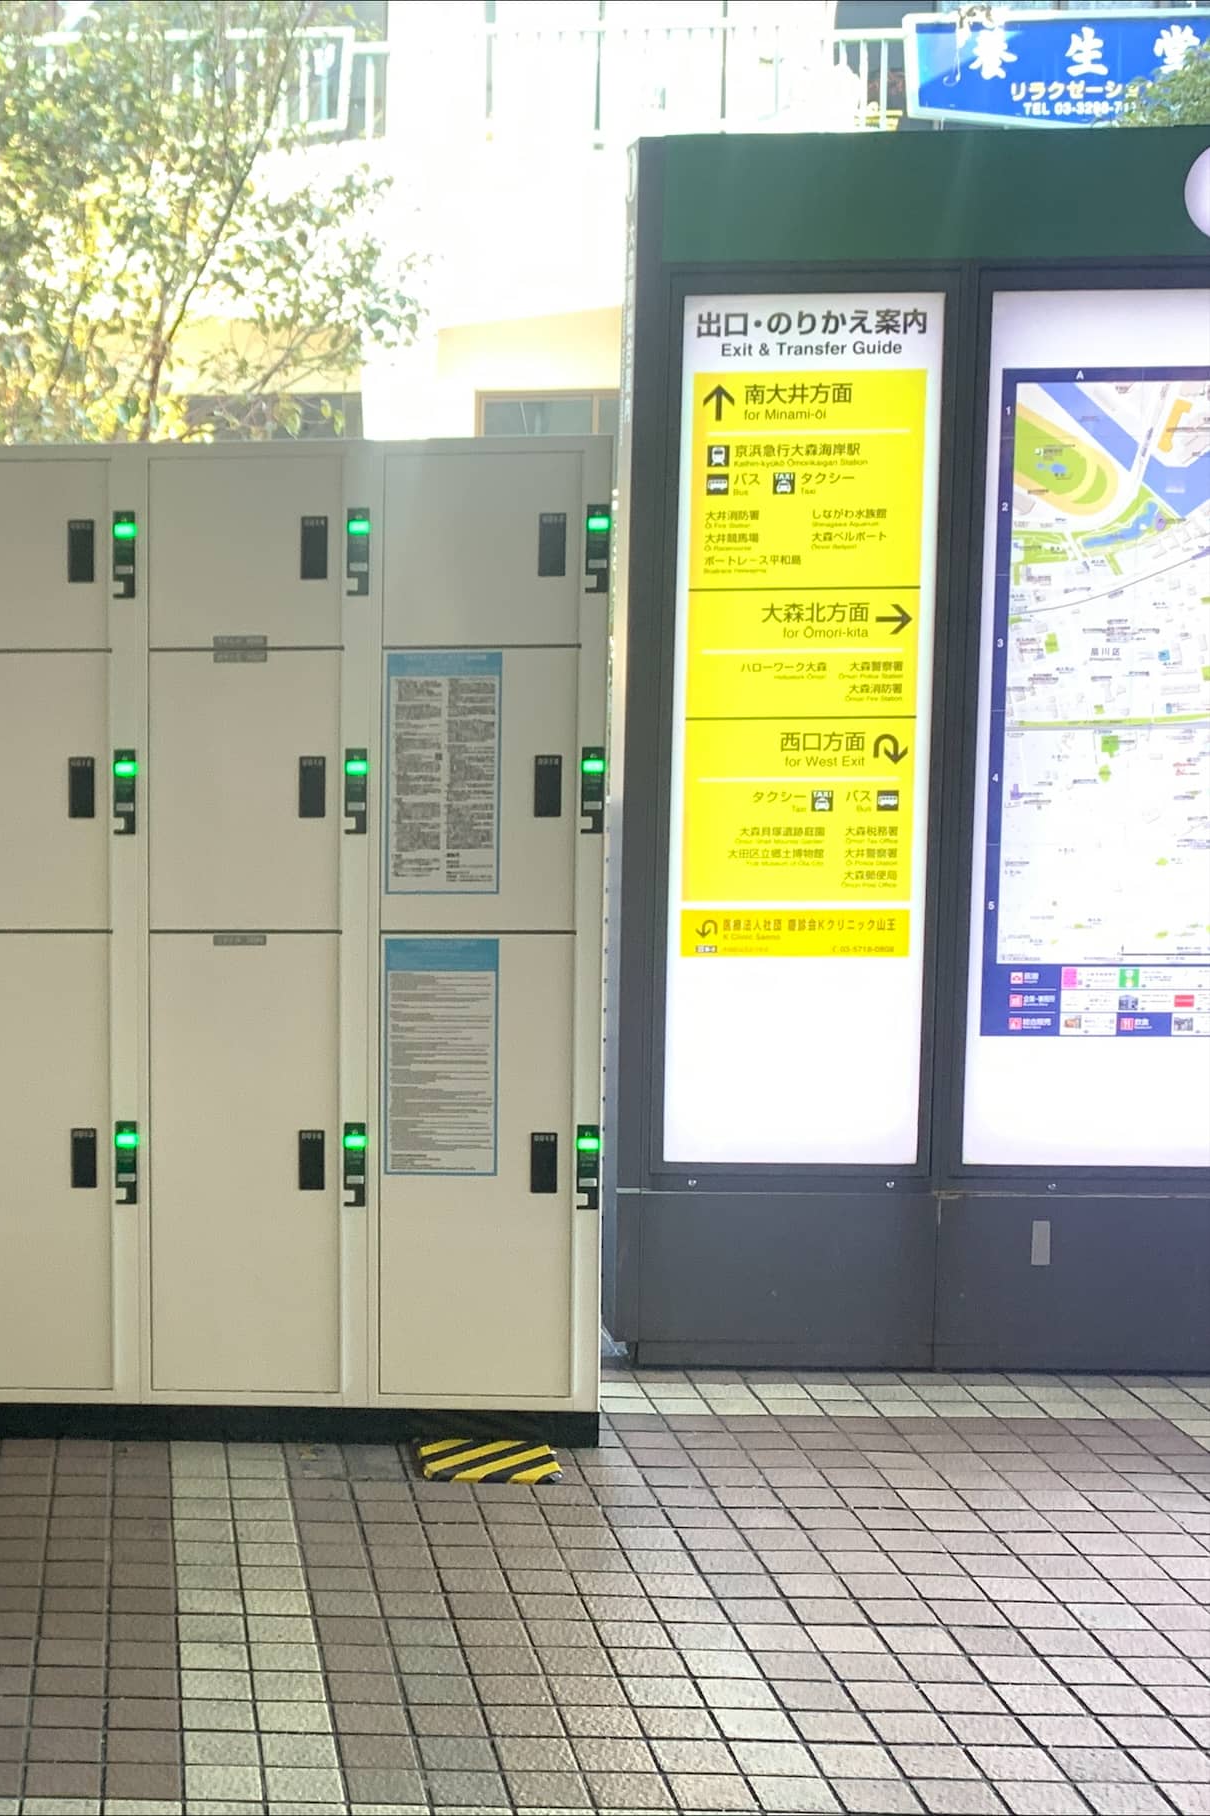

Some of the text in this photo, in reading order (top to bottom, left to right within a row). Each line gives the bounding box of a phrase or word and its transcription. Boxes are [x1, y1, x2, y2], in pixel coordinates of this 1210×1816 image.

[1023, 102, 1050, 116] TEL
[697, 308, 928, 338] 出口・のりかえ案内
[721, 341, 902, 357] Exit & Transfer Guide
[1076, 370, 1084, 380] A
[744, 383, 853, 405] 南大井方面
[744, 408, 761, 421] for
[1006, 405, 1012, 416] 1
[734, 443, 860, 458] 京浜急行大森海岸駅
[733, 472, 761, 486] バス
[774, 473, 794, 481] TAXI
[800, 472, 855, 485] タクシー
[1002, 502, 1008, 512] 2
[761, 602, 870, 624] 大森北方面
[783, 626, 799, 638] for
[997, 638, 1004, 648] 3
[741, 662, 827, 674] ハローワーク大森
[780, 731, 866, 752] 西口方面
[785, 755, 865, 768] for West Exit
[991, 773, 999, 783] 4
[752, 790, 806, 803] タクシー
[846, 789, 872, 802] バス
[988, 901, 995, 911] 5
